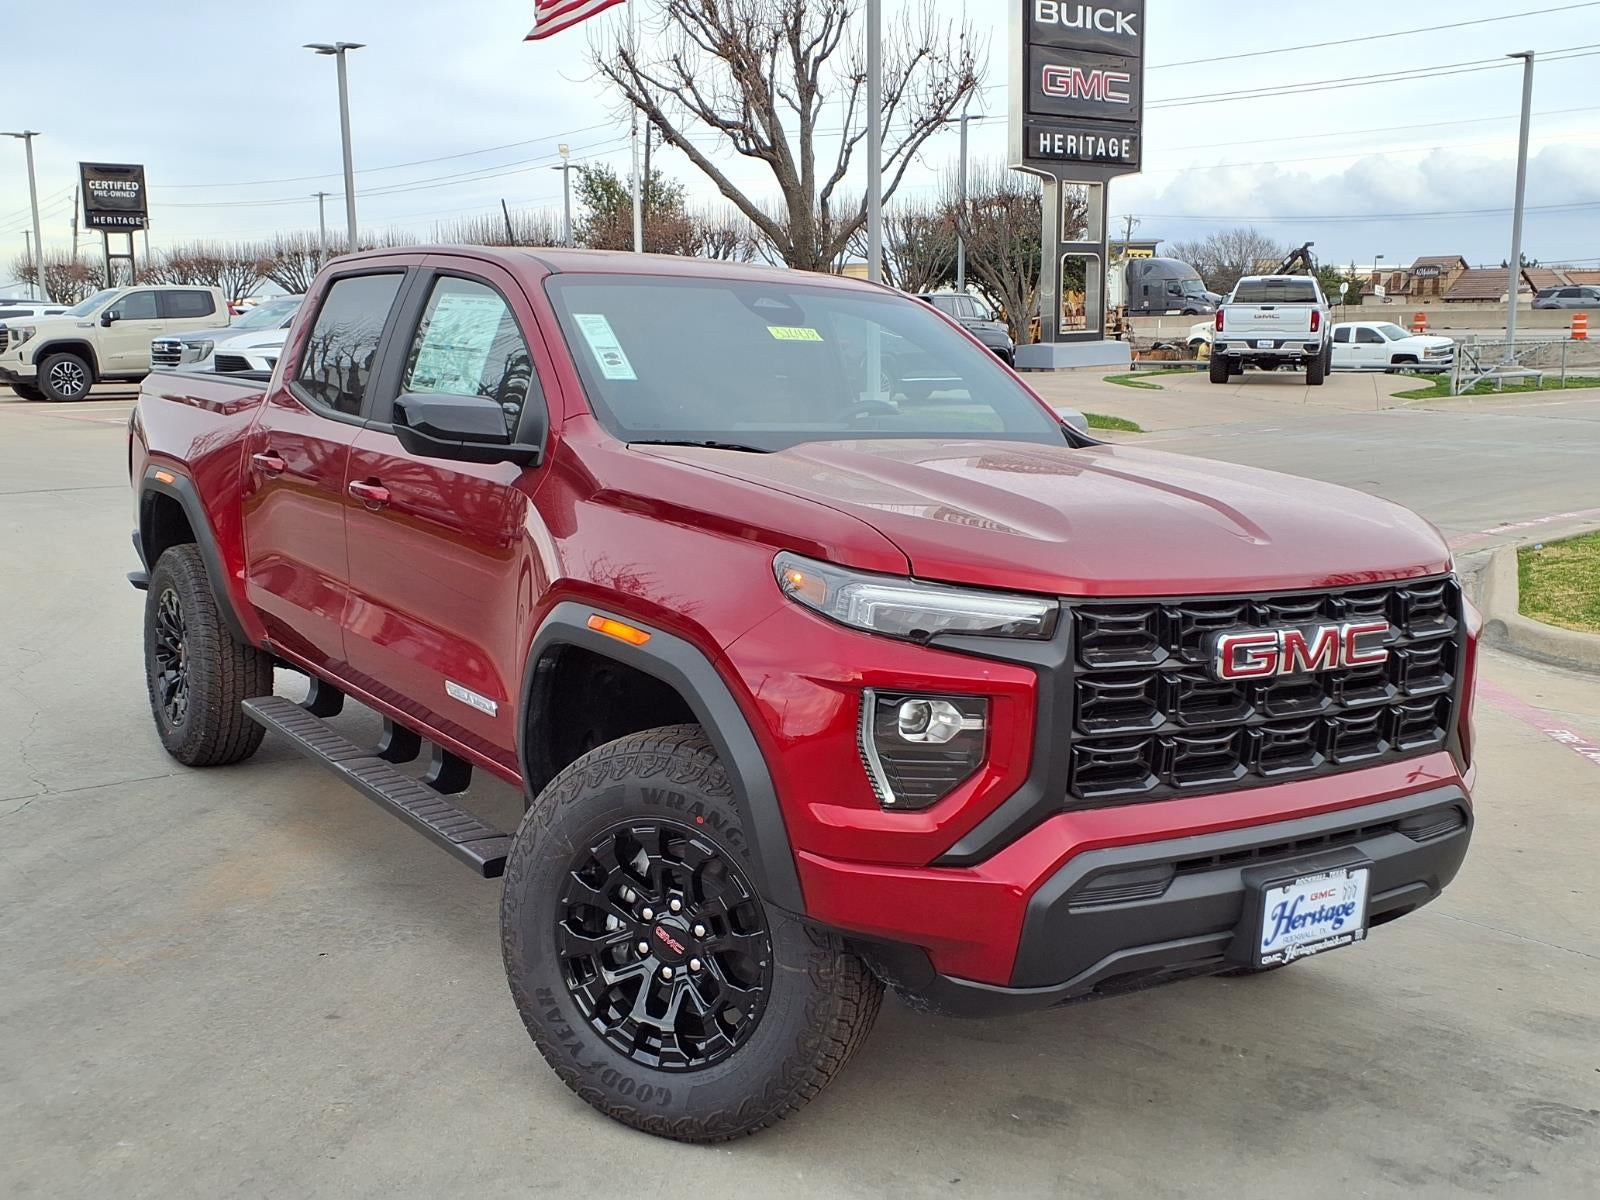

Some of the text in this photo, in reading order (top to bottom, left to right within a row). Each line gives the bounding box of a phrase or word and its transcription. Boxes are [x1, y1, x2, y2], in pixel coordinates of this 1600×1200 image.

[1034, 0, 1138, 36] BUICK
[1042, 64, 1130, 104] GMC
[1039, 132, 1131, 158] HERITAGE
[88, 180, 139, 191] CERTIFIED
[93, 190, 136, 198] PRE-OWNED
[93, 216, 142, 225] HERITAGE
[1216, 621, 1390, 681] GMC
[1310, 888, 1337, 901] GMC
[1263, 895, 1356, 947] Heritage
[655, 926, 685, 955] GMC
